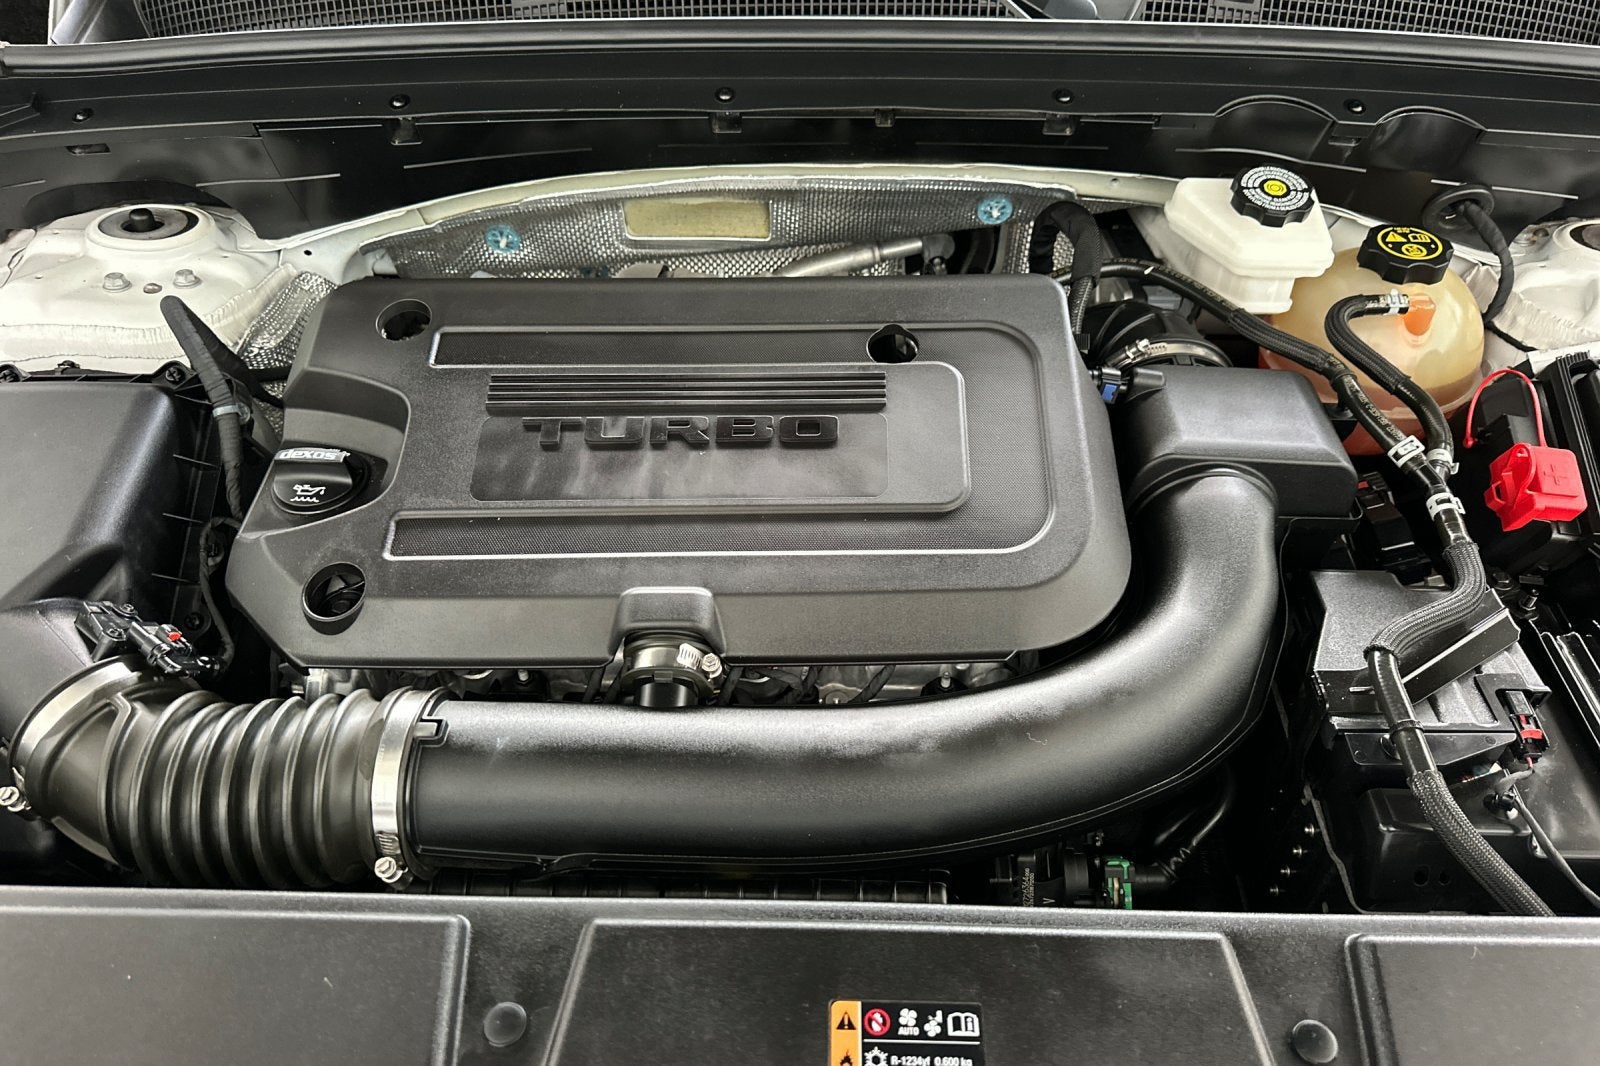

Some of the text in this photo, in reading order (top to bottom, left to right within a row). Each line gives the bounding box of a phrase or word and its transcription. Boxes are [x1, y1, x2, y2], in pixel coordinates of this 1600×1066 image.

[522, 415, 839, 445] TURBO
[279, 449, 337, 460] dexos
[897, 1026, 920, 1036] AUTO
[934, 1056, 959, 1066] 0.600
